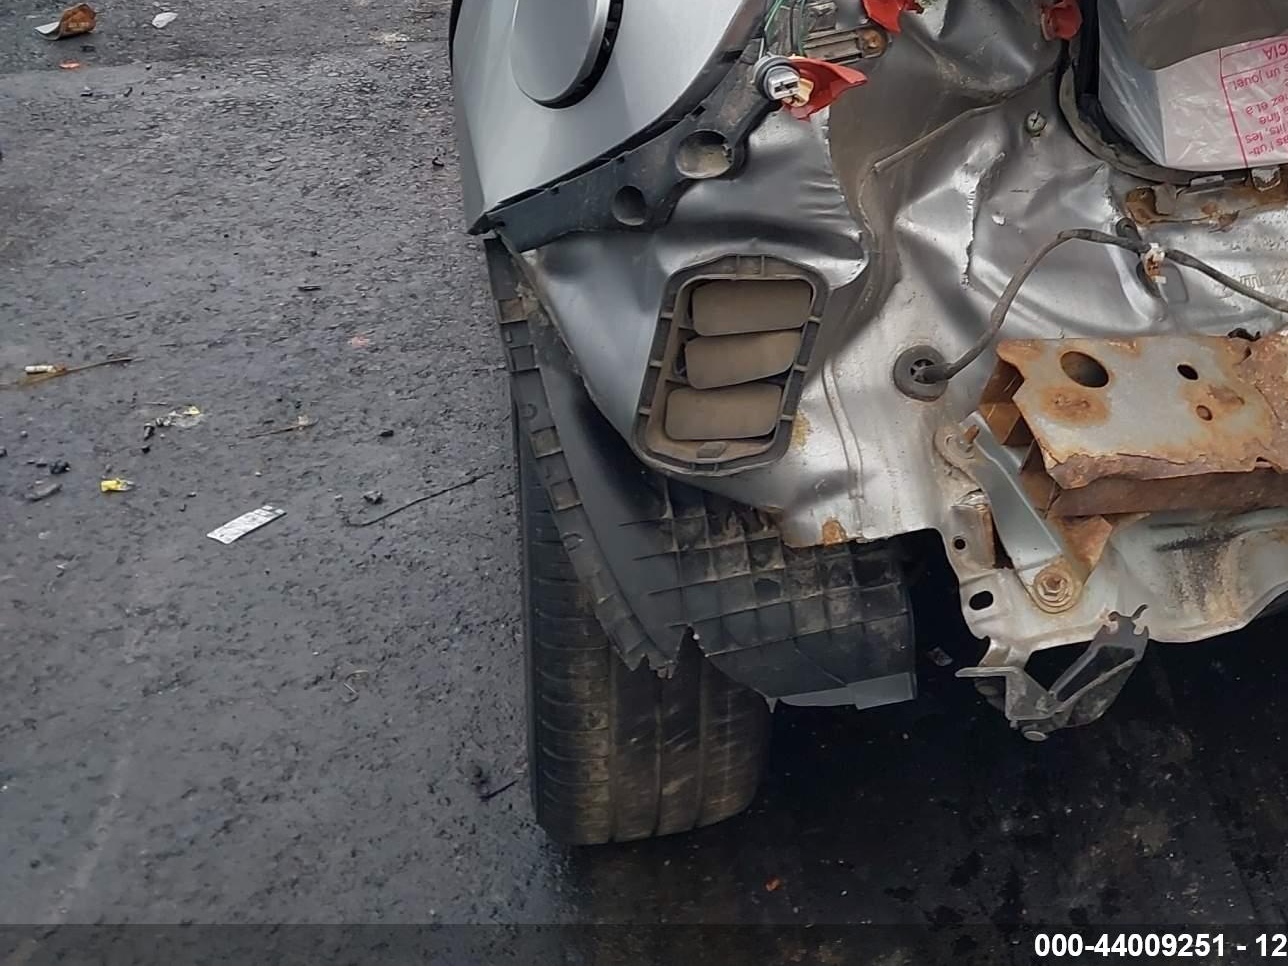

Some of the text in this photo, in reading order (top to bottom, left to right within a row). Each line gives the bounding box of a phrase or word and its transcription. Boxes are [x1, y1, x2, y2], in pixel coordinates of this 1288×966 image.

[1265, 68, 1280, 78] un
[1229, 70, 1262, 90] jouet.
[1244, 132, 1263, 144] les
